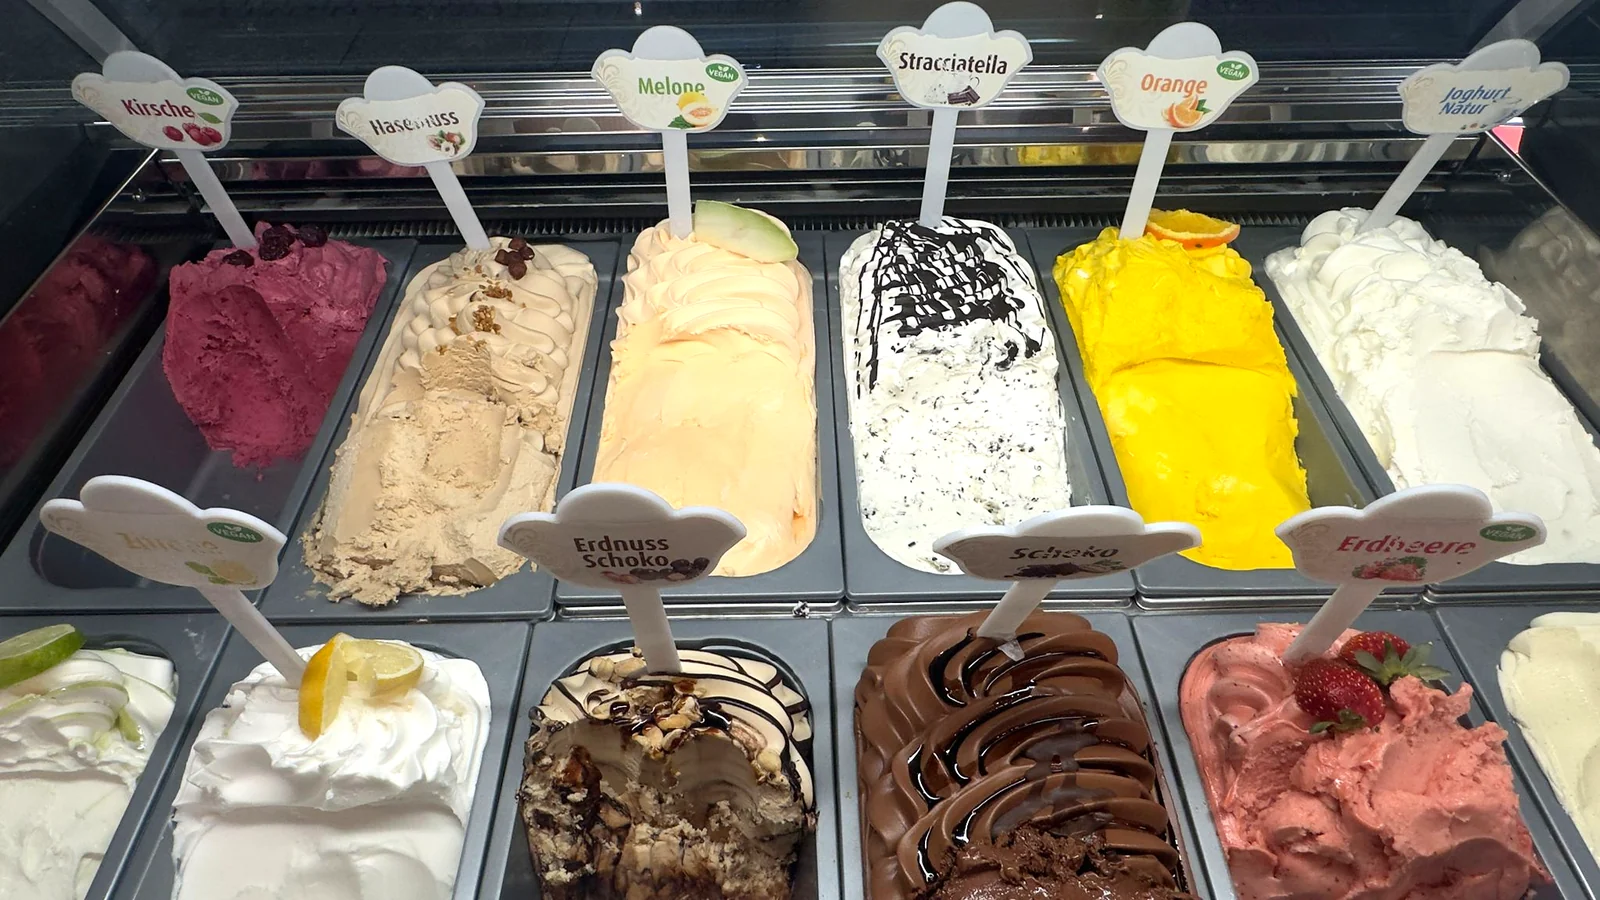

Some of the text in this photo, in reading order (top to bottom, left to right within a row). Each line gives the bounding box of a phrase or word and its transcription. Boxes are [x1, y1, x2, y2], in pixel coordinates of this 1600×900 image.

[898, 52, 1008, 75] Stracciatella
[708, 69, 734, 81] VEGAN
[1219, 66, 1245, 79] VEGAN
[638, 76, 706, 95] Melone
[1141, 73, 1208, 98] Orange
[191, 92, 220, 104] VEGAN
[1440, 85, 1512, 105] Joghurt
[121, 98, 196, 118] Kirsche
[1439, 101, 1490, 115] Natur
[369, 111, 460, 136] Hasenuss
[211, 527, 257, 542] VEGAN
[1485, 528, 1527, 541] VEGAN
[573, 535, 670, 553] Erdnuss
[1337, 535, 1477, 555] Erdbeere
[582, 552, 670, 569] Schoko
[1008, 545, 1119, 561] Schoko
